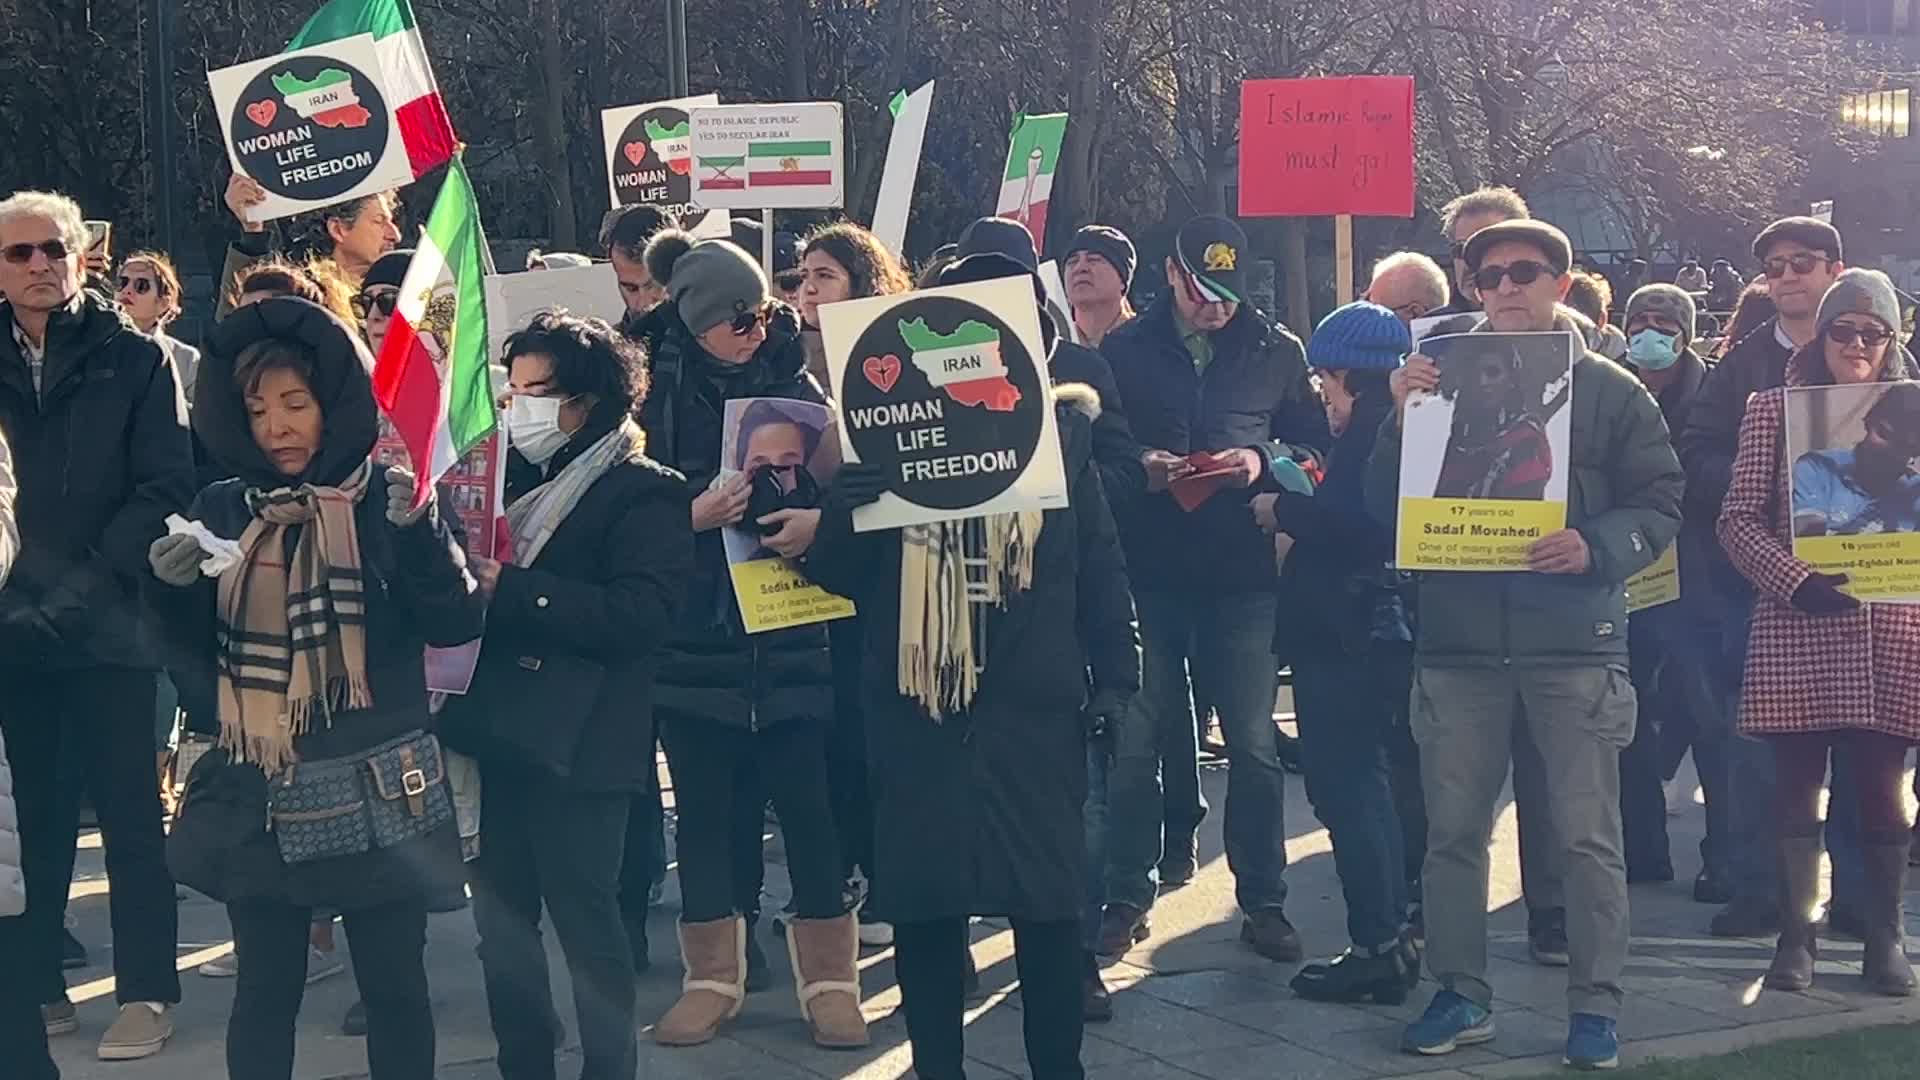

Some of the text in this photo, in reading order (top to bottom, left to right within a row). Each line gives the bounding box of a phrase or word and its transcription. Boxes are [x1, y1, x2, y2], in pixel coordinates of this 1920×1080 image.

[309, 91, 339, 106] IRAN
[1267, 92, 1353, 126] Islamic
[711, 118, 722, 126] TO
[723, 117, 757, 126] ISLAMIC
[759, 115, 800, 125] REPUBLIC
[238, 125, 313, 155] WOMAN
[667, 143, 689, 153] IRAN
[275, 143, 318, 166] LIFE
[1285, 143, 1339, 172] must
[281, 151, 373, 187] FREEDOM
[616, 169, 667, 188] WOMAN
[640, 187, 669, 202] LIFE
[943, 354, 982, 373] IRAN
[849, 399, 944, 430] WOMAN
[896, 426, 948, 452] LIFE
[901, 449, 1018, 483] FREEDOM
[1450, 506, 1465, 516] 17
[1423, 522, 1541, 537] Sadaf Movahedi
